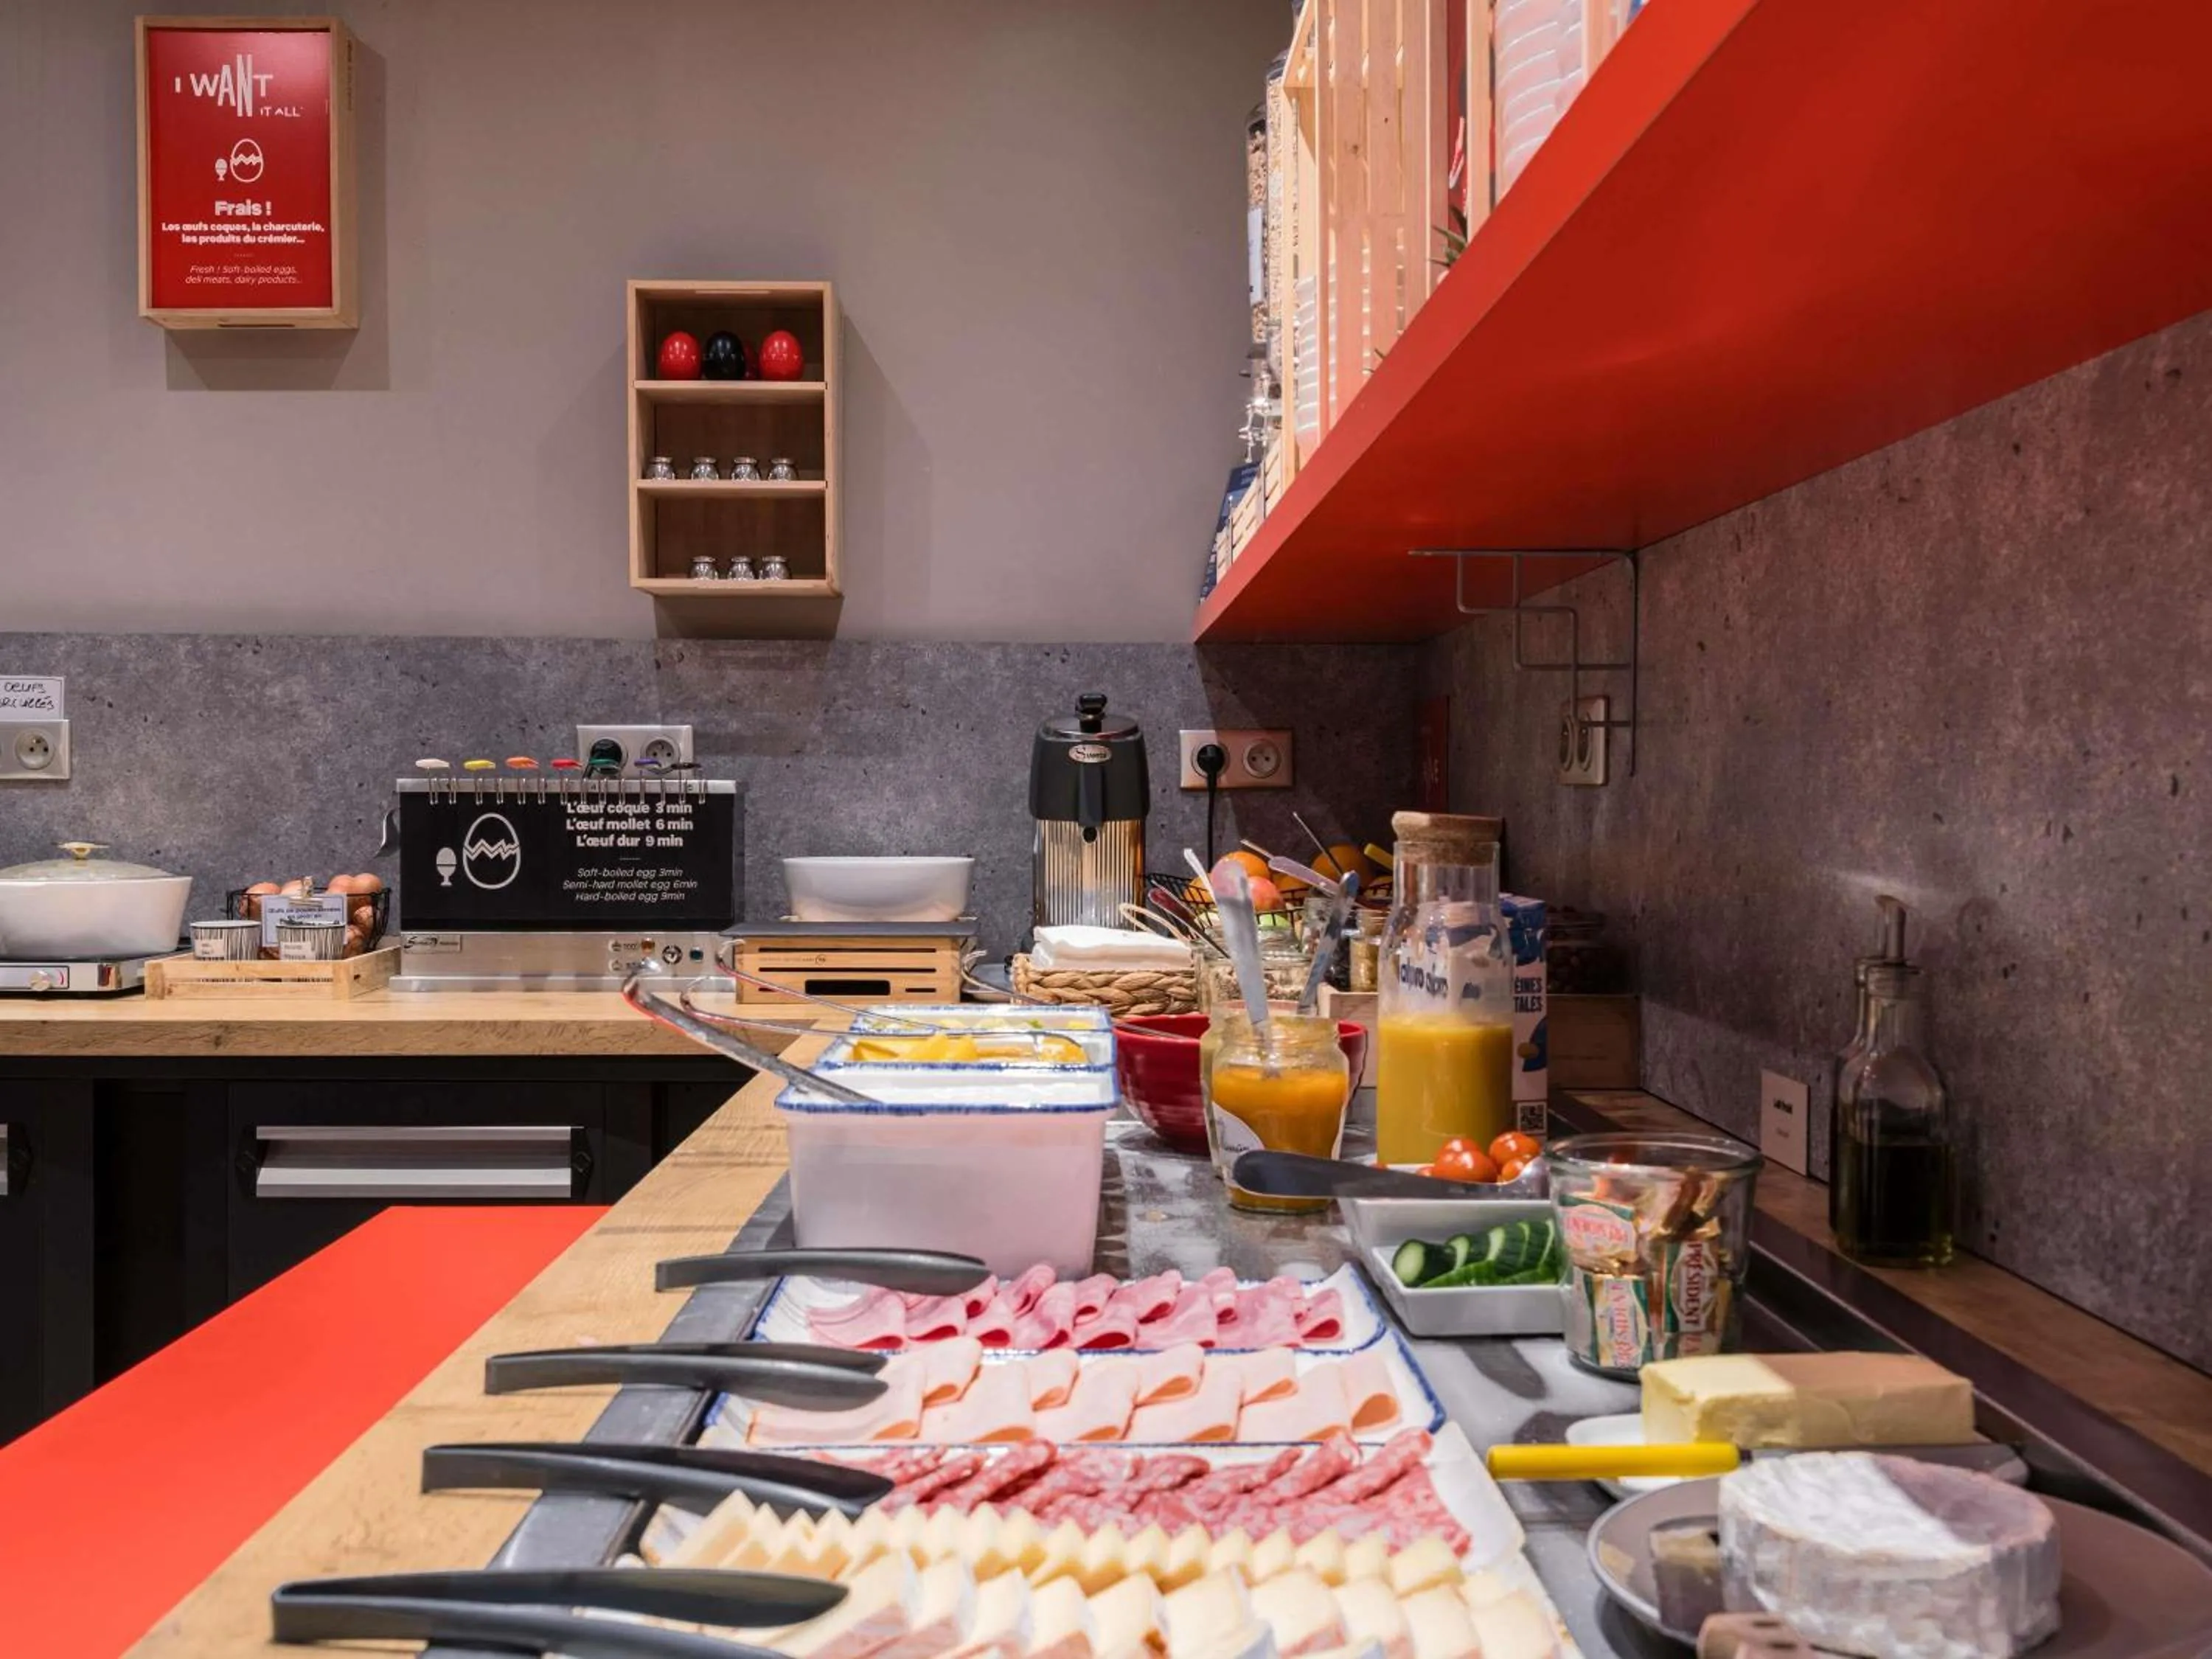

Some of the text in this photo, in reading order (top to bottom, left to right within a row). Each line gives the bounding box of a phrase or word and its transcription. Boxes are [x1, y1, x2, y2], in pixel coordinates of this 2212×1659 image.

[175, 54, 274, 117] I WANT
[260, 106, 272, 116] IT
[215, 198, 272, 216] Frais !
[210, 223, 251, 233] coques,
[251, 222, 262, 232] la
[262, 222, 325, 232] charcuterie,
[181, 234, 198, 243] les
[198, 234, 241, 245] produits
[243, 234, 256, 243] du
[189, 265, 215, 274] Fresh
[607, 802, 650, 816] coque
[655, 801, 664, 814] 3
[667, 801, 693, 814] min
[606, 817, 651, 831] mollet
[655, 818, 665, 831] 6
[667, 817, 695, 831] min
[616, 834, 641, 847] dur
[645, 835, 655, 847] 9
[657, 834, 684, 847] min
[577, 868, 635, 878] Soft-boiled
[636, 869, 657, 879] egg
[617, 880, 649, 889] mollet
[650, 881, 671, 891] egg
[575, 891, 636, 902] Hard-boiled
[638, 893, 658, 903] egg
[1514, 995, 1543, 1013] TALES
